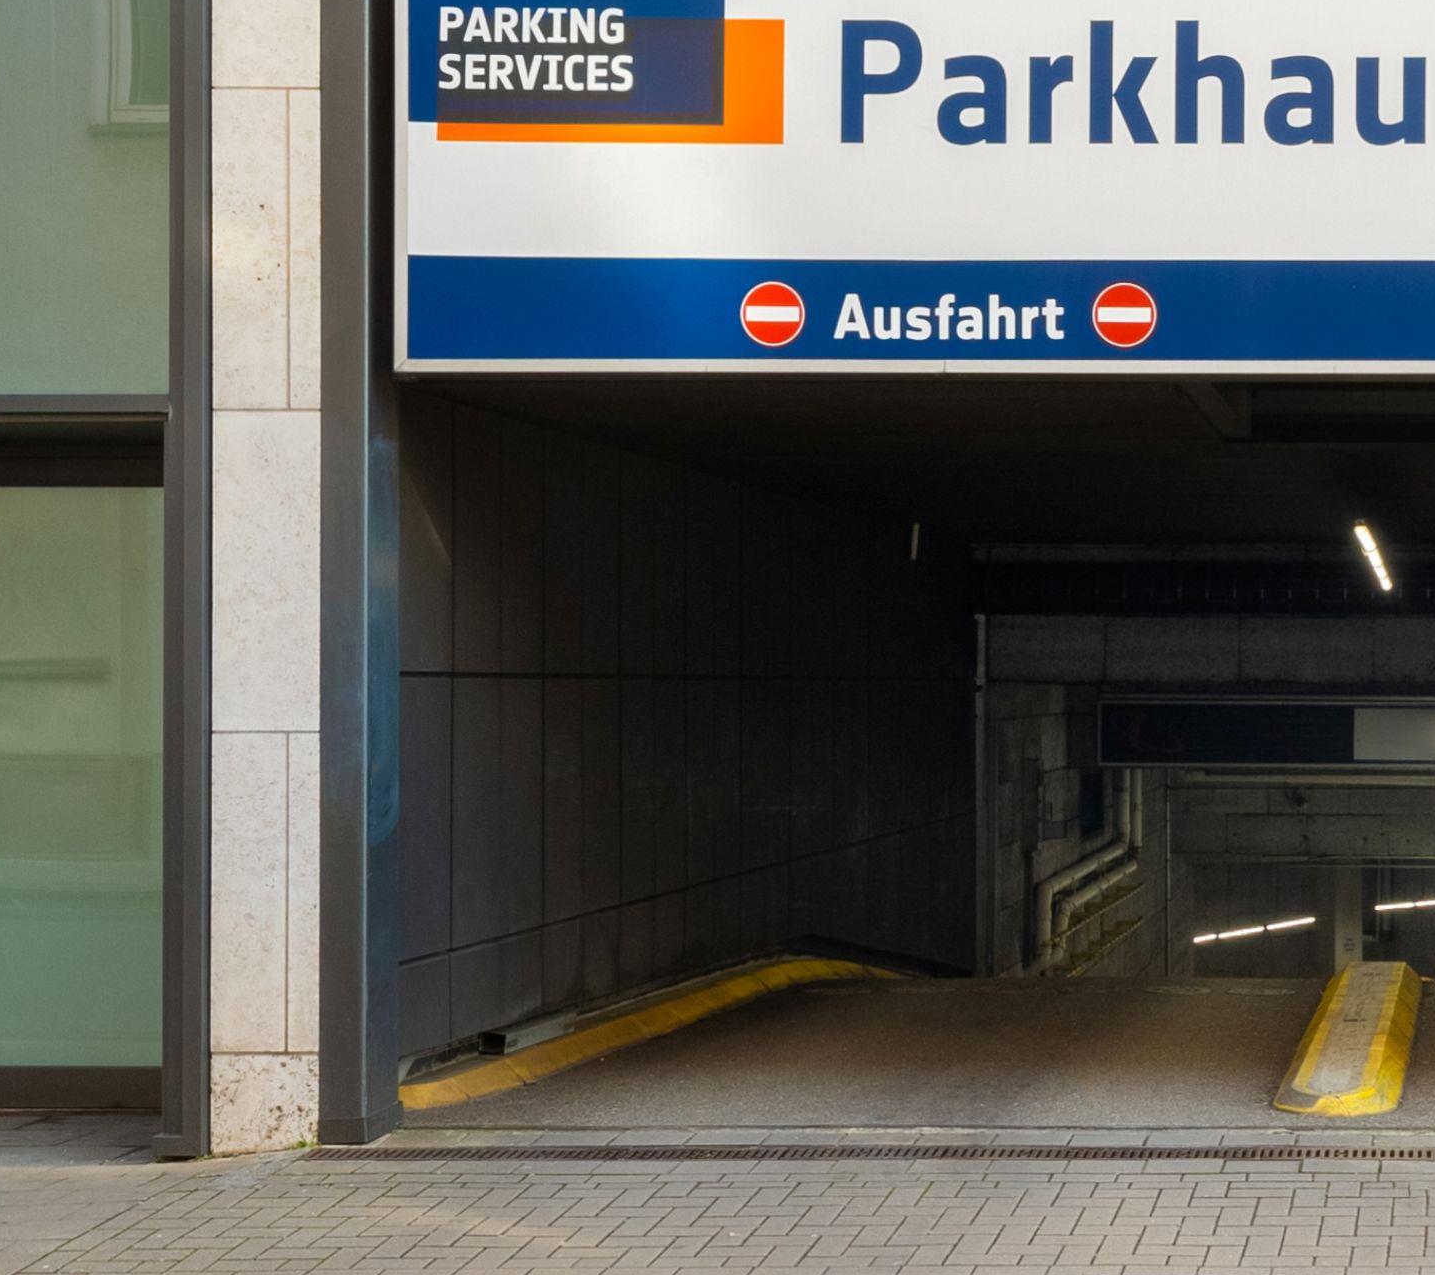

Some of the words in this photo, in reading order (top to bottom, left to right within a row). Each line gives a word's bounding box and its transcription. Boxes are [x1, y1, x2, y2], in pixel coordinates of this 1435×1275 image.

[437, 4, 627, 46] PARKING
[436, 50, 635, 94] SERVICES
[831, 290, 1067, 342] Ausfahrt
